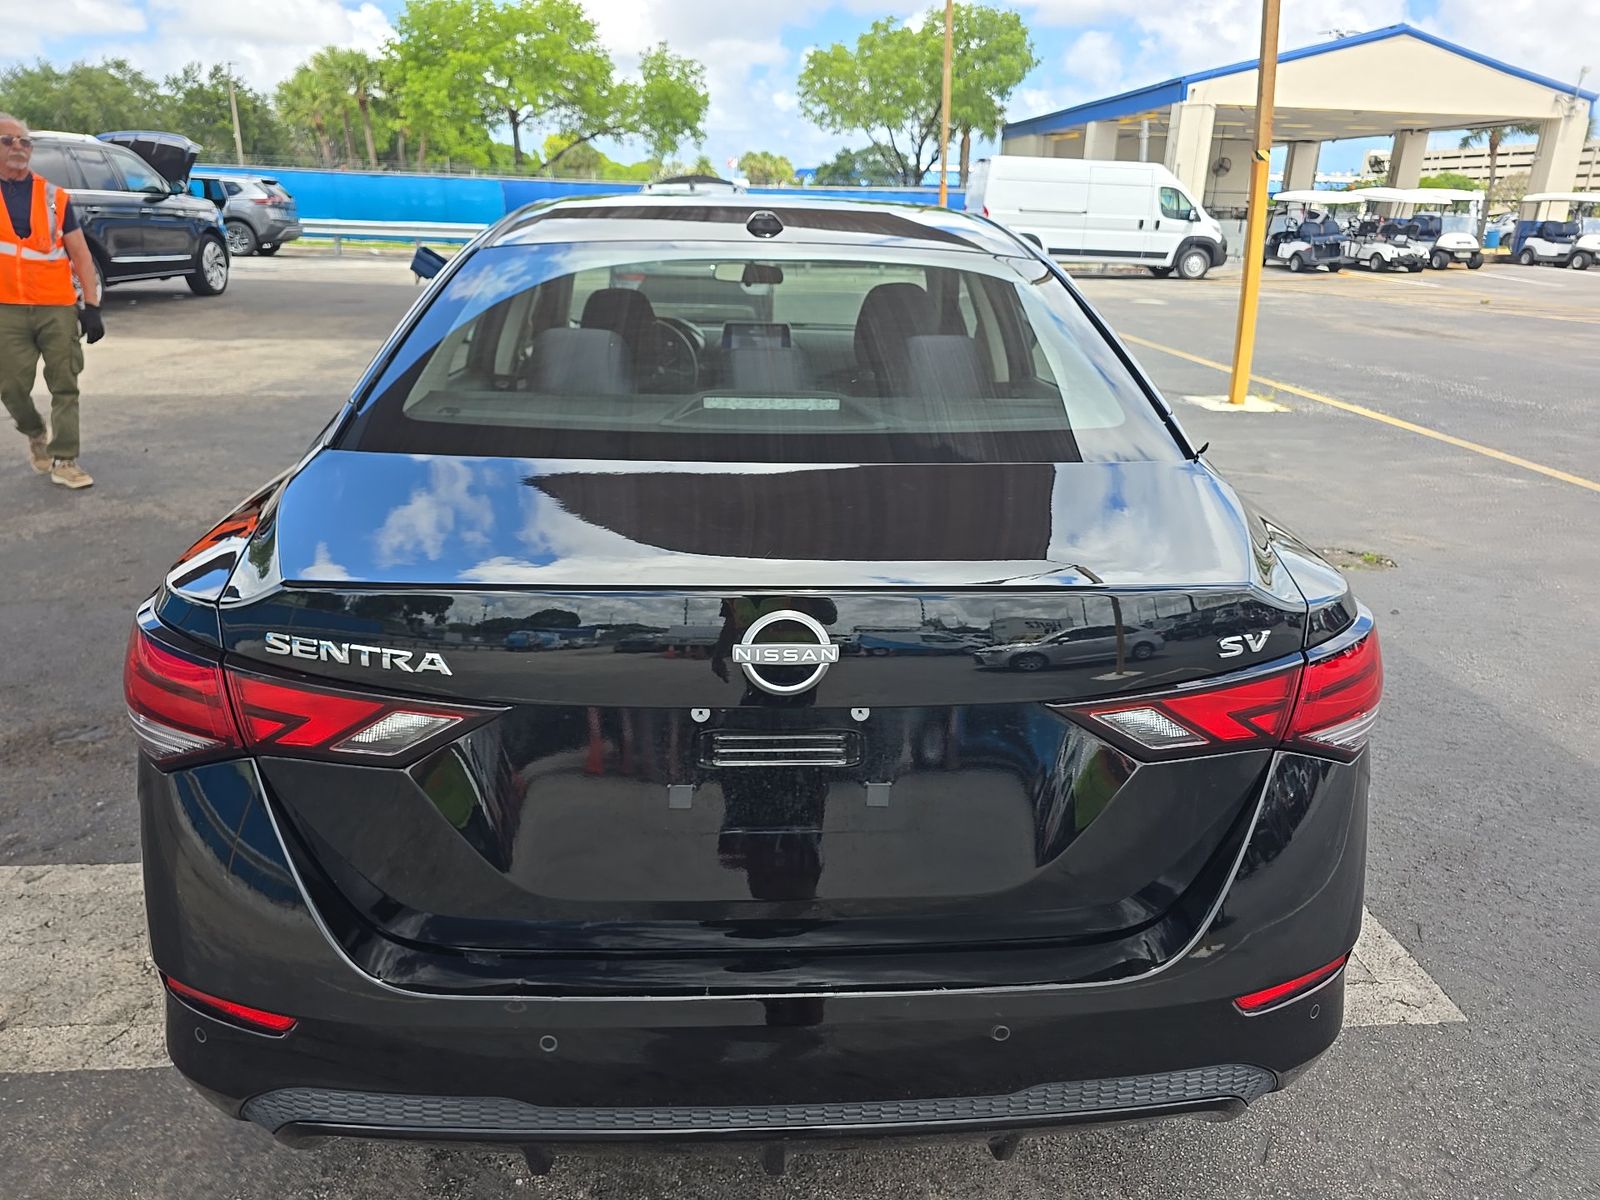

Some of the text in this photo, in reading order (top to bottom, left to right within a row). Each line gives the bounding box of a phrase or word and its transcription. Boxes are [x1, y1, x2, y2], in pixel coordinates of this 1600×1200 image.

[264, 631, 453, 676] SENTRA
[734, 647, 837, 662] NISSAN
[1218, 629, 1272, 659] SV
